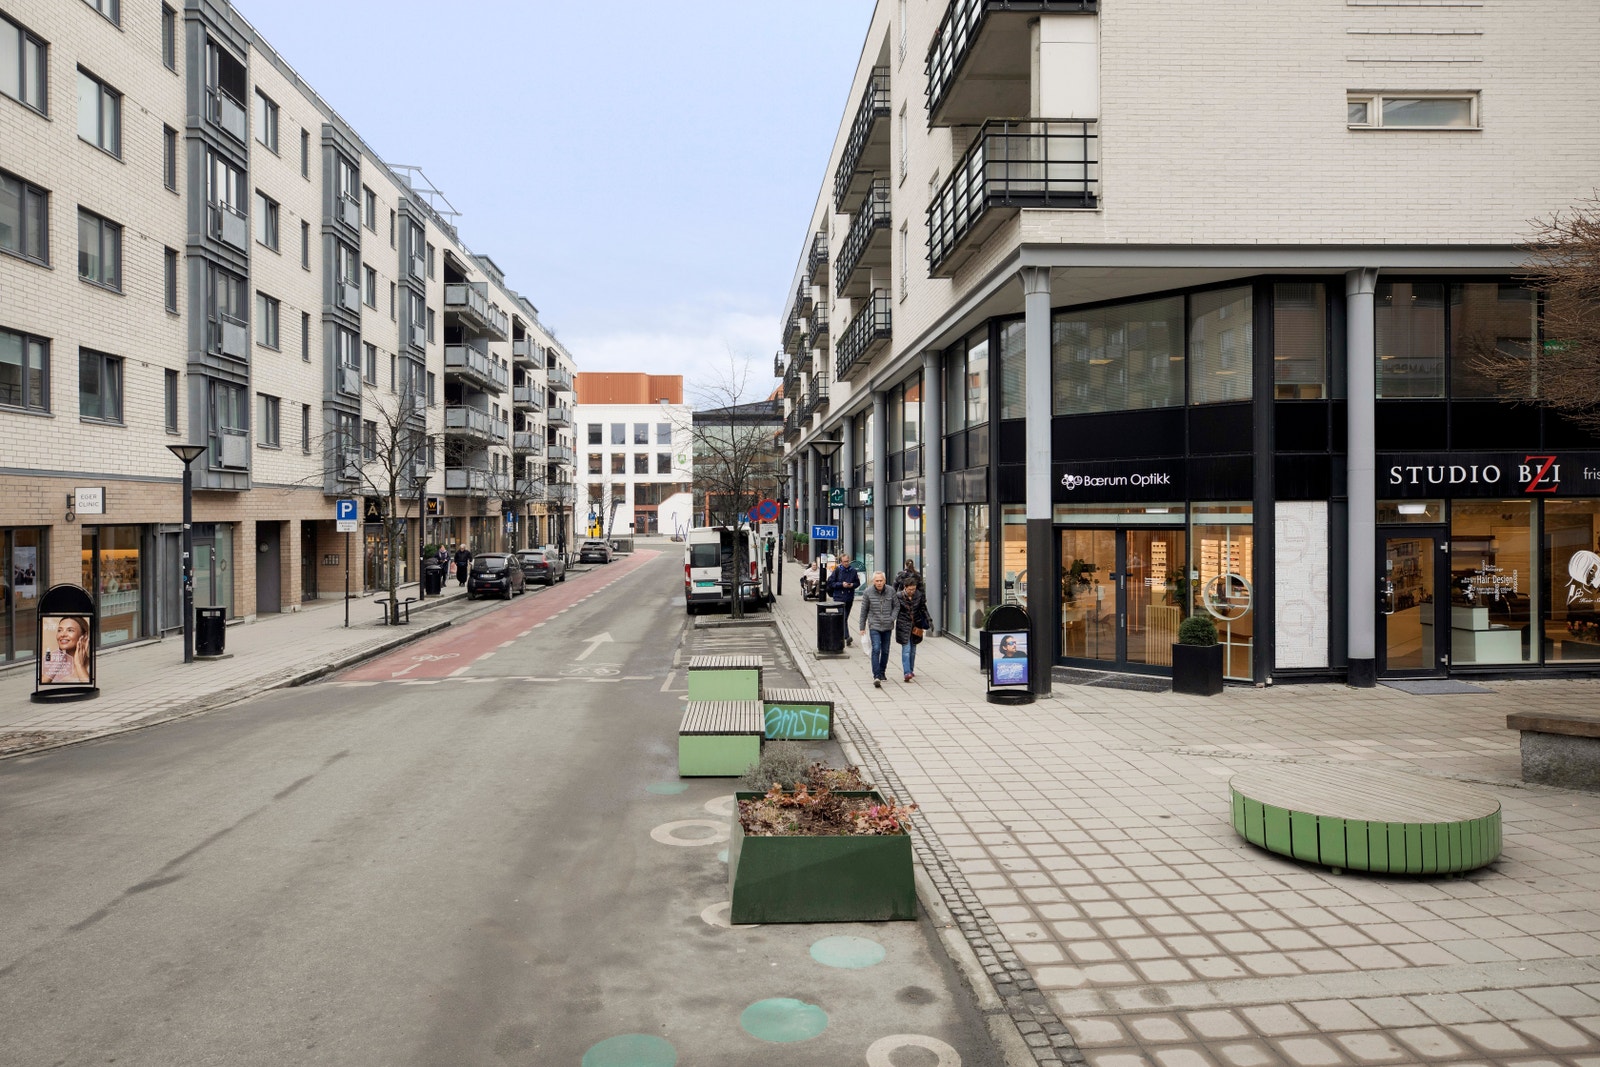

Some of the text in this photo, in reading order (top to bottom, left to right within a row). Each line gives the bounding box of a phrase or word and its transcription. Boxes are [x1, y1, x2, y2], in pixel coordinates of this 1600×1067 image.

[1084, 472, 1171, 488] Bærum Optikk
[1390, 464, 1501, 484] STUDIO
[341, 502, 353, 518] P
[427, 501, 437, 509] W
[815, 527, 835, 537] Taxi
[1476, 575, 1491, 584] Hair
[1492, 575, 1513, 586] Design
